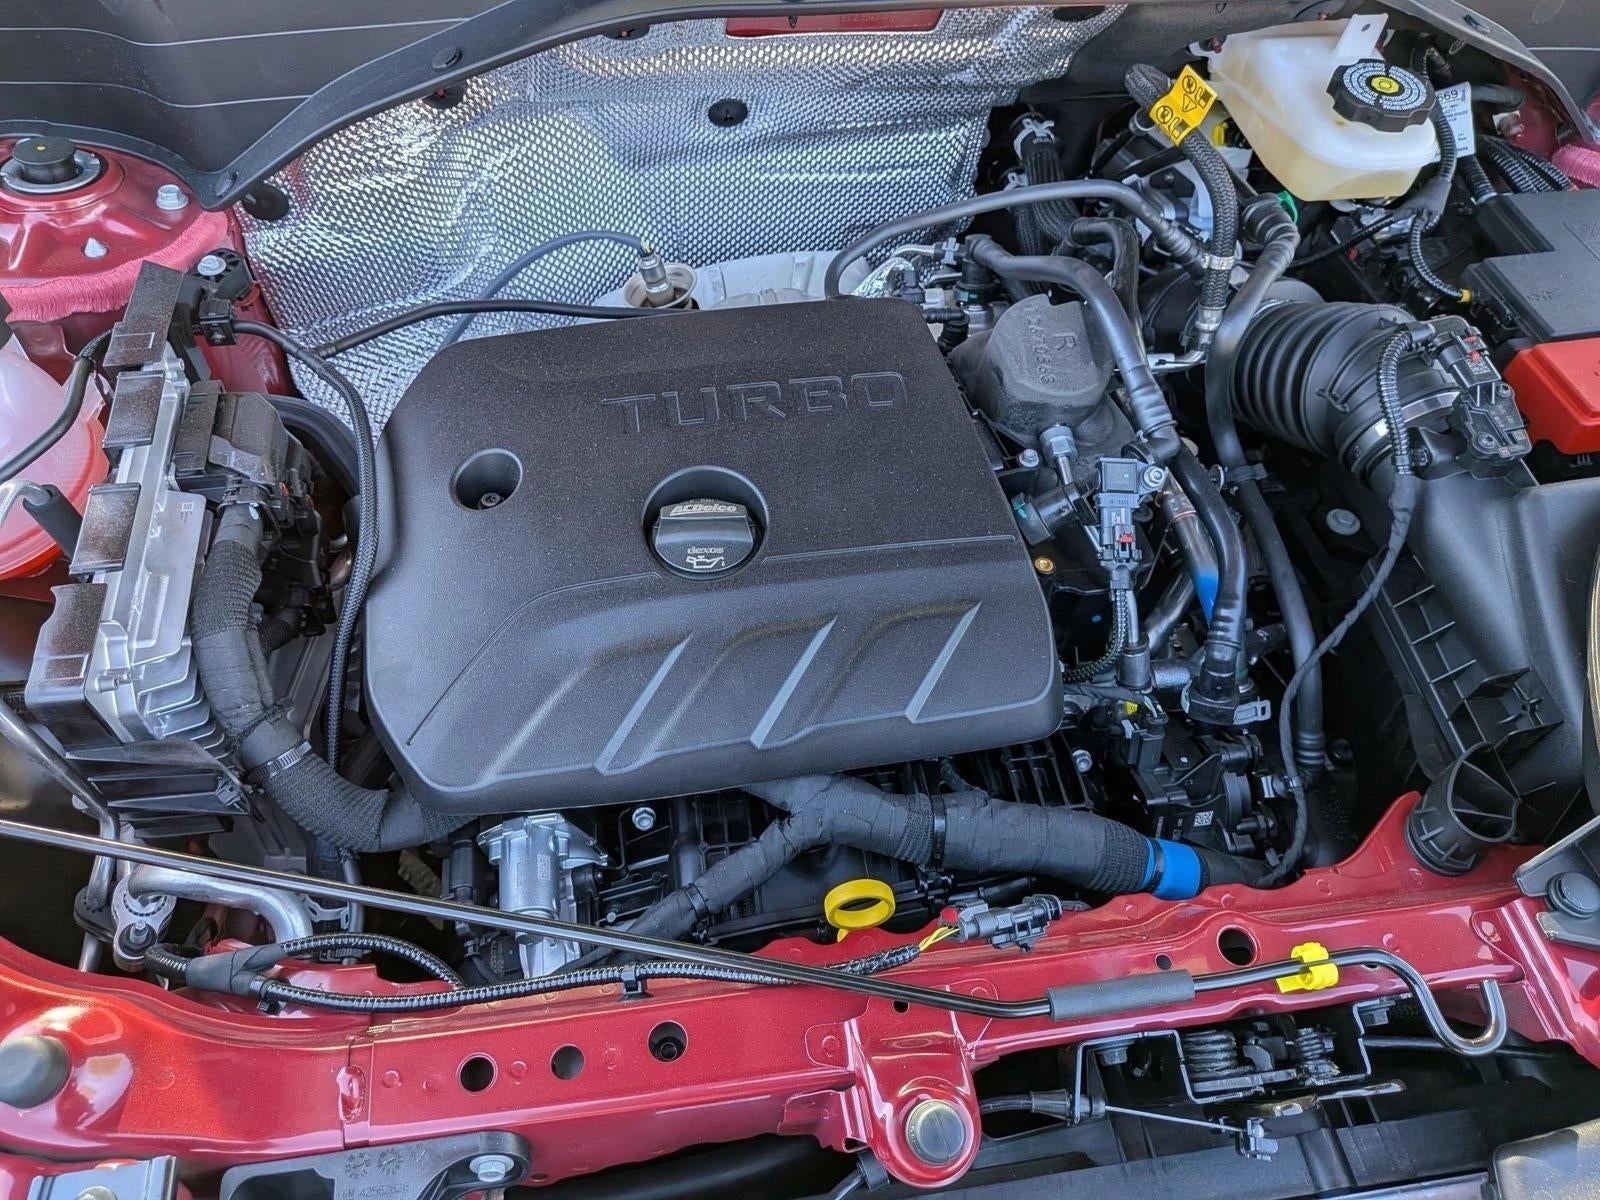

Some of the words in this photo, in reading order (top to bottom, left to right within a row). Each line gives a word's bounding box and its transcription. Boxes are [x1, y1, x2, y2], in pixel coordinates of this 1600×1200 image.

[602, 371, 908, 433] TURBO
[670, 503, 738, 516] ACDelco
[687, 546, 724, 555] dexos
